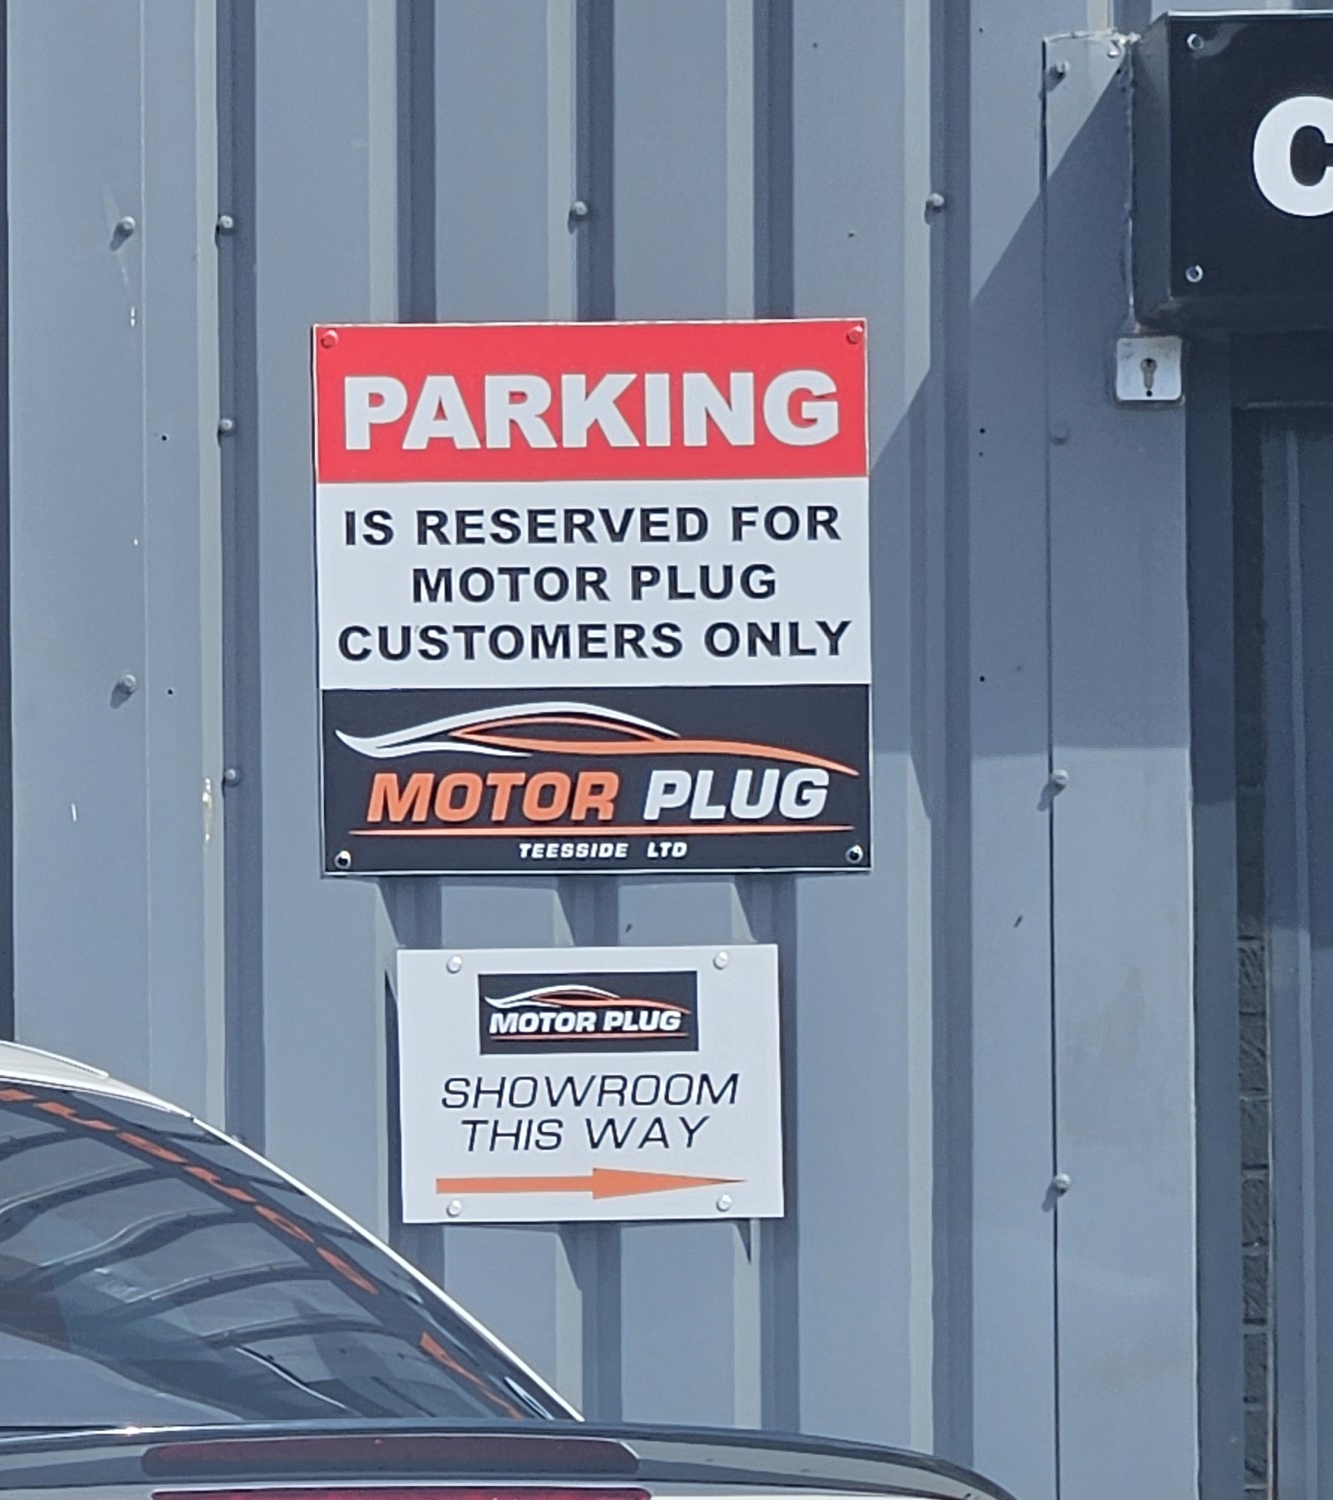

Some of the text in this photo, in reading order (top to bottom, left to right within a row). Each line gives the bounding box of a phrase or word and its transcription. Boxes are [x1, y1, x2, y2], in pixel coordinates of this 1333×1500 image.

[344, 370, 840, 450] PARKING
[345, 504, 843, 546] IS RESERVED FOR
[412, 563, 778, 604] MOTOR PLUG
[338, 620, 852, 661] CUSTOMERS ONLY
[366, 768, 830, 823] MOTOR PLUG
[518, 840, 688, 859] TEESSIDE LTD
[489, 1009, 683, 1034] MOTOR PLUG
[441, 1072, 740, 1109] SHOWROOM
[461, 1115, 711, 1152] THIS WAY
